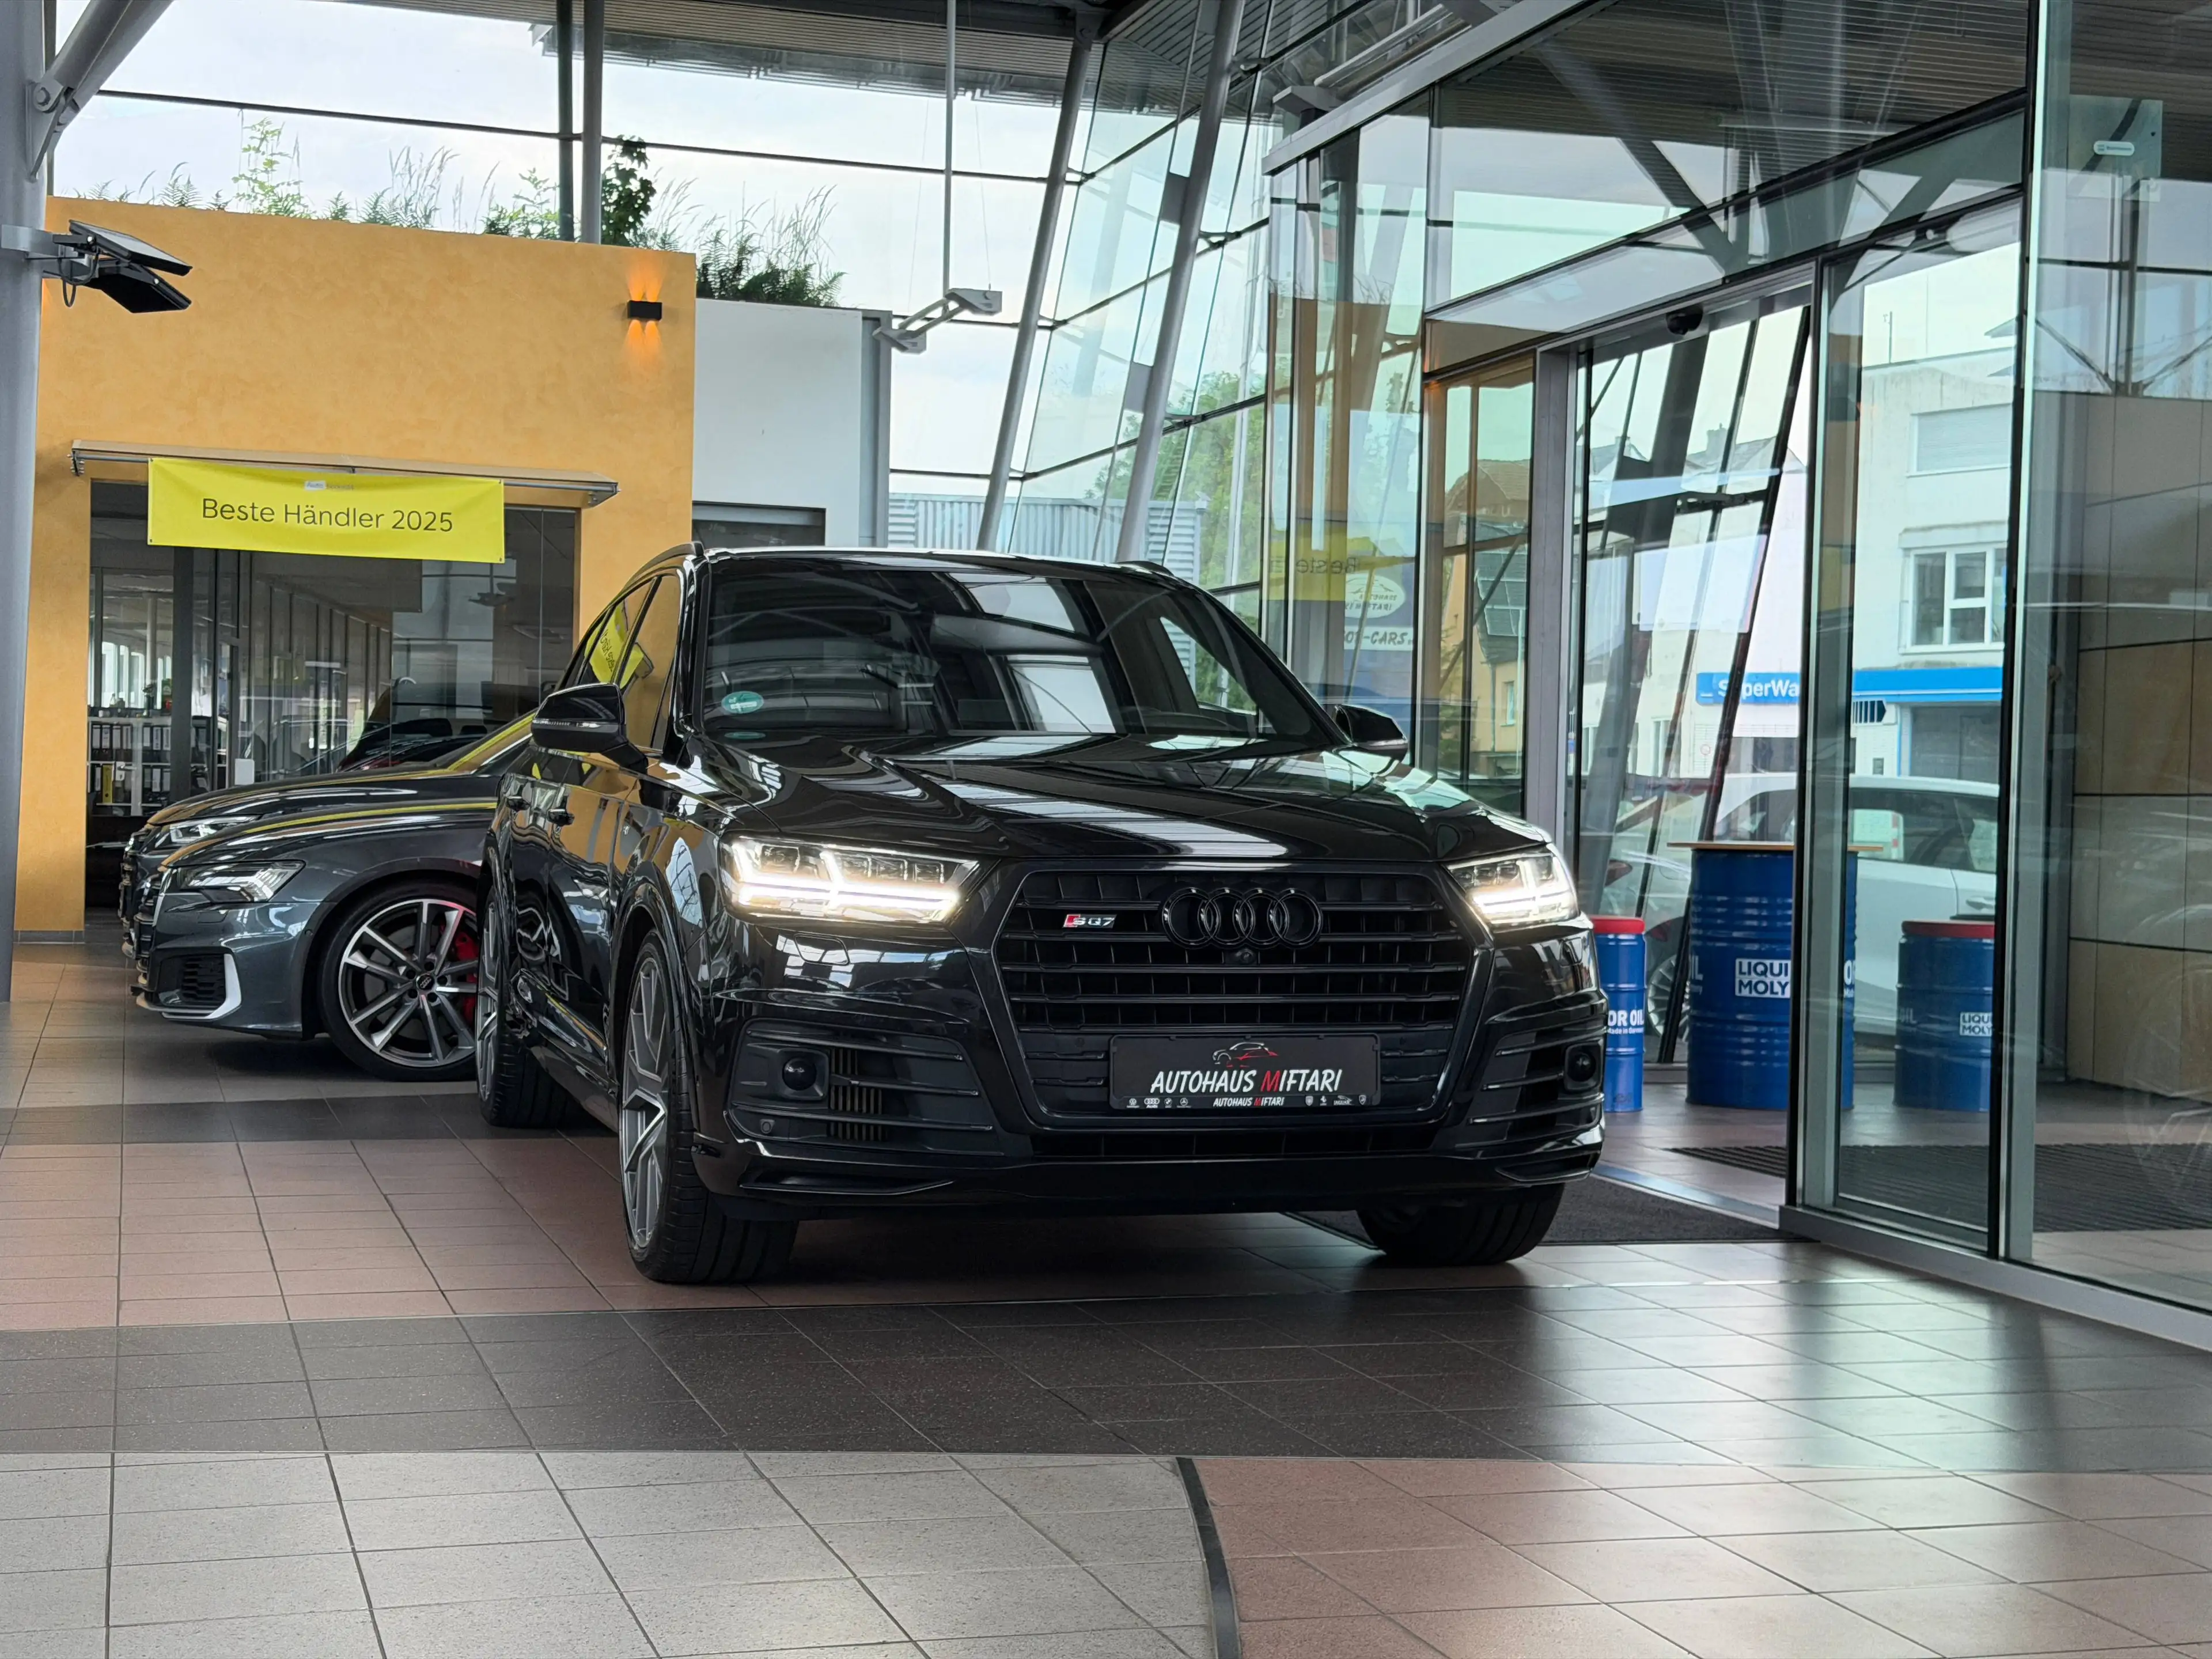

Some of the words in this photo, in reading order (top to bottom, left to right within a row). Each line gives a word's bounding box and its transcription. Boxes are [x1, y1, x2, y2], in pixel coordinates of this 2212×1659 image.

[203, 498, 275, 523] Beste
[284, 503, 384, 529] Händler
[391, 509, 453, 532] 2025
[1718, 679, 1799, 700] SperWa
[1070, 916, 1115, 927] SQ7
[1738, 961, 1789, 978] LIQUI
[1738, 980, 1790, 996] MOLY
[1607, 1010, 1628, 1027] OR
[1630, 1009, 1645, 1026] OIL
[1962, 1014, 1990, 1024] LIQU
[1150, 1069, 1257, 1093] AUTOHAUS
[1260, 1069, 1343, 1093] MIFTARI
[1213, 1097, 1252, 1107] AUTOHAUS
[1253, 1097, 1285, 1107] MIFTARI
